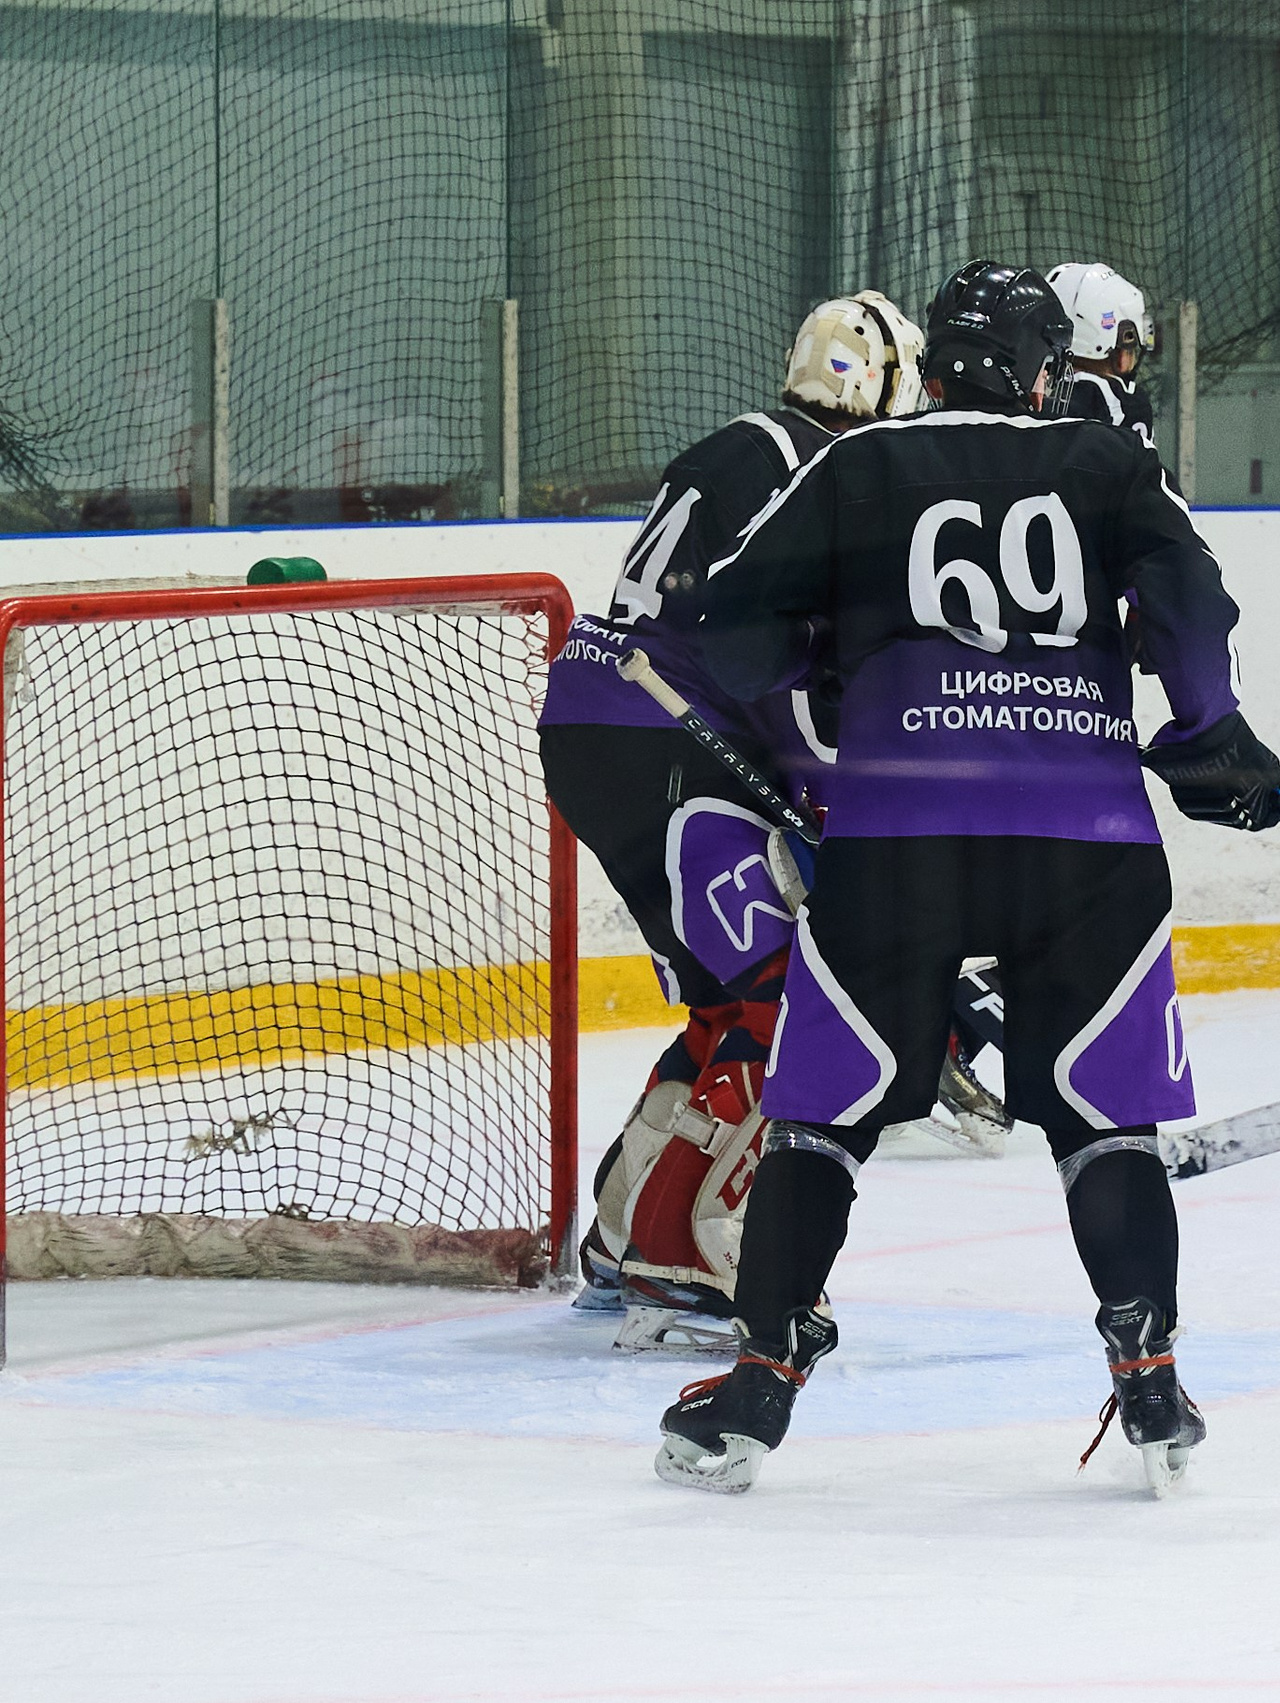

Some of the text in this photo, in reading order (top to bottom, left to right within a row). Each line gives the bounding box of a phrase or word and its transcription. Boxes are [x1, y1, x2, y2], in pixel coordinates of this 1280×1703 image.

[908, 491, 1088, 654] 69
[941, 670, 1104, 703] ЦИФРОВАЯ
[902, 705, 1133, 743] СТОМАТОЛОГИЯ
[688, 719, 782, 805] CATALYST
[1109, 1315, 1144, 1328] NEXT
[1112, 1310, 1140, 1322] CCM
[798, 1324, 828, 1343] NEXT
[804, 1321, 828, 1337] CCM
[680, 1396, 715, 1412] CCM
[730, 1457, 748, 1469] CCM
